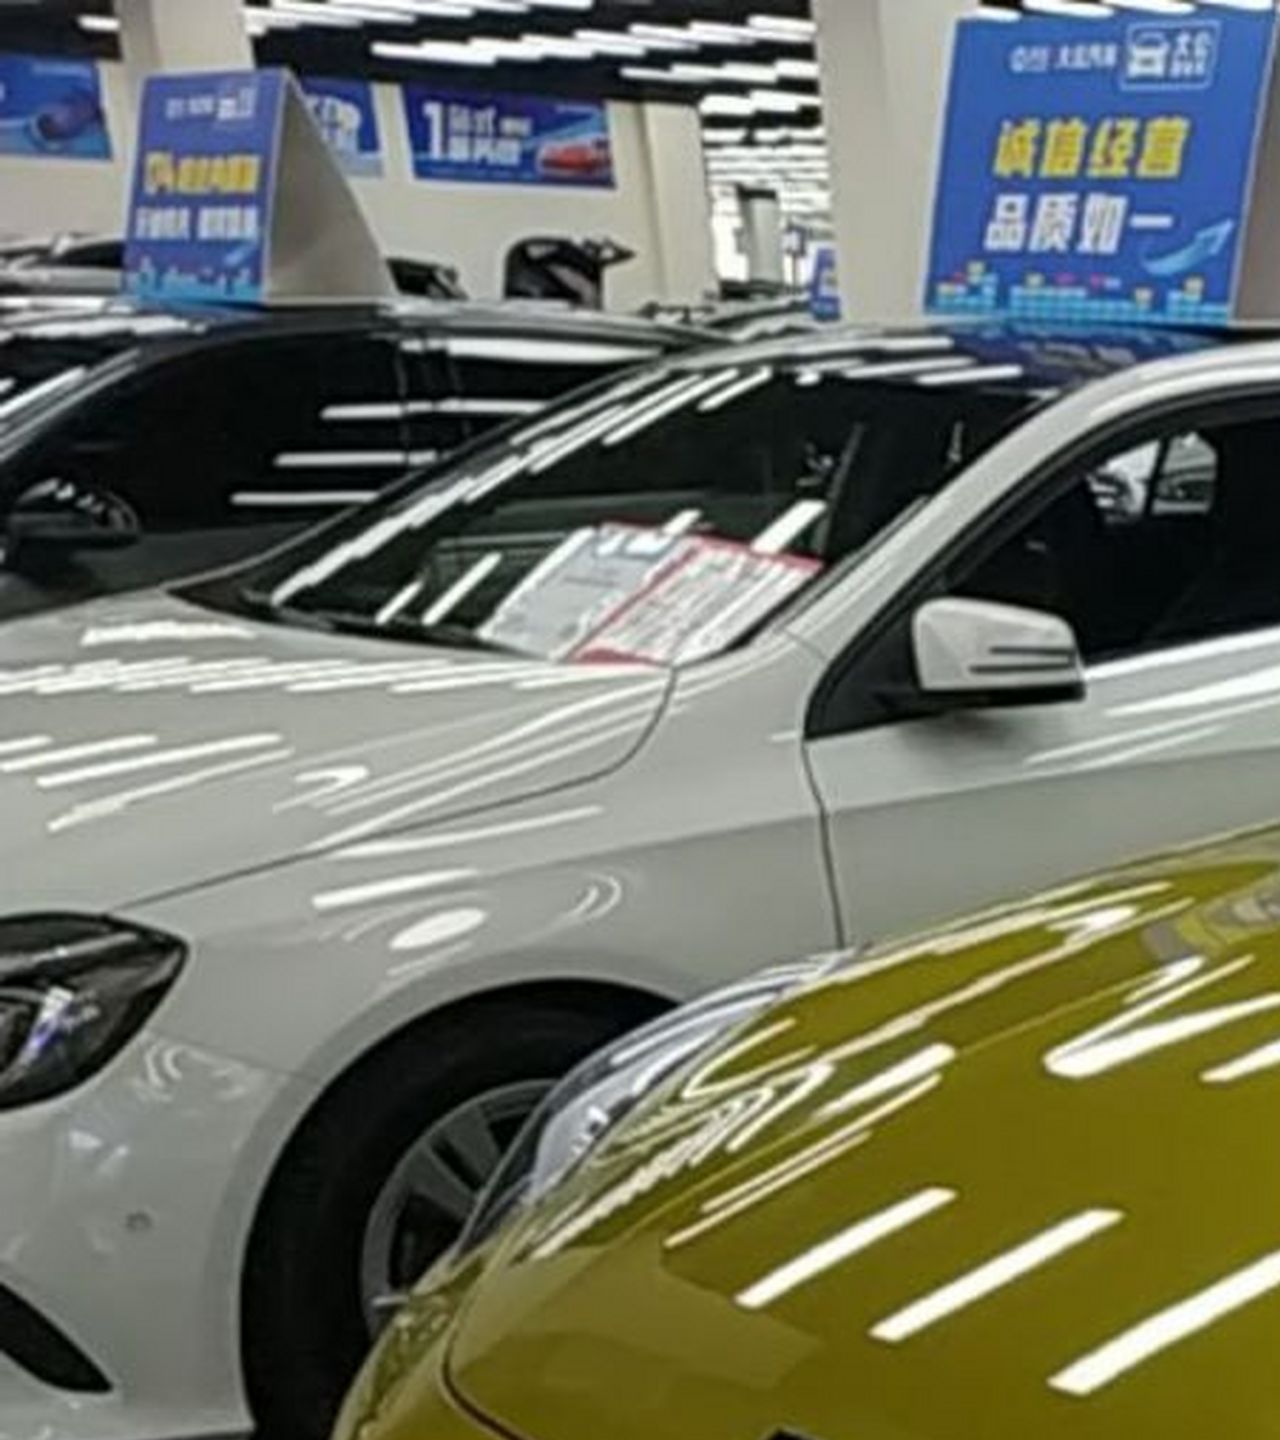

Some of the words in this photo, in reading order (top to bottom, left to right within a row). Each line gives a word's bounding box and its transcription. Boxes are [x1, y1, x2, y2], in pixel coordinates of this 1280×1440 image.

[993, 117, 1191, 178] 诚信经营
[983, 192, 1174, 254] 品质如一
